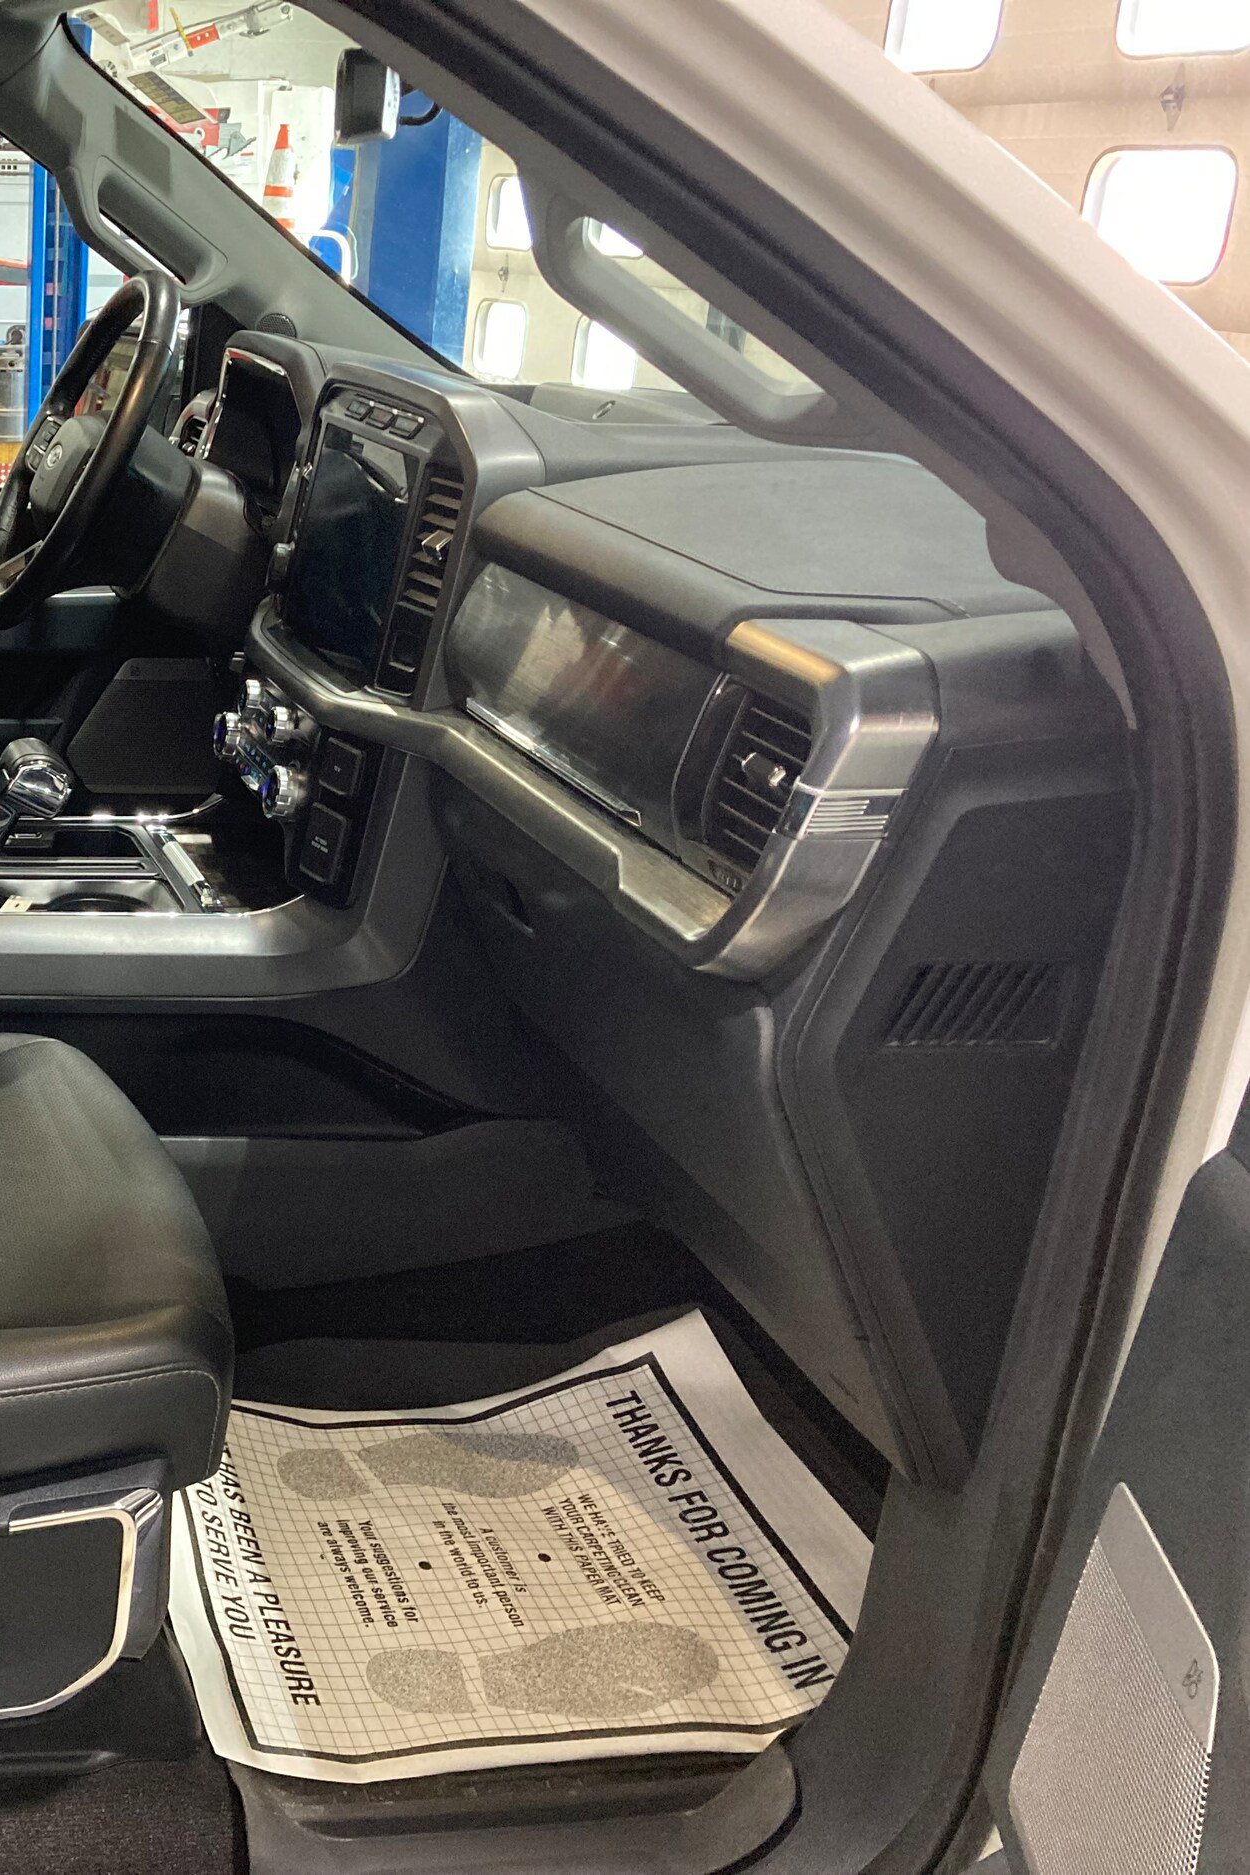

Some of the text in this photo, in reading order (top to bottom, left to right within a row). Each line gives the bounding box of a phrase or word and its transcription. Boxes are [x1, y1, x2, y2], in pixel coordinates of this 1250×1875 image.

[218, 1461, 246, 1503] HAS
[195, 1481, 256, 1640] TO SERVE YOU
[229, 1508, 265, 1565] BEEN
[249, 1570, 271, 1585] A
[317, 1521, 375, 1627] are always welcome.
[358, 1520, 419, 1622] Your suggestions for
[432, 1520, 488, 1608] in the world to us.
[442, 1502, 524, 1628] the most important person
[485, 1536, 521, 1581] customer
[512, 1583, 528, 1593] is
[541, 1506, 621, 1606] WITH THIS PAPER MAT
[559, 1498, 645, 1607] YOUR CARPETING CLEAN
[578, 1494, 665, 1602] WE HAVE TRIED TO KEEP
[606, 1390, 835, 1690] THANKS FOR COMING IN
[361, 1567, 378, 1584] our
[371, 1587, 398, 1627] service
[253, 1592, 320, 1706] PLEASURE
